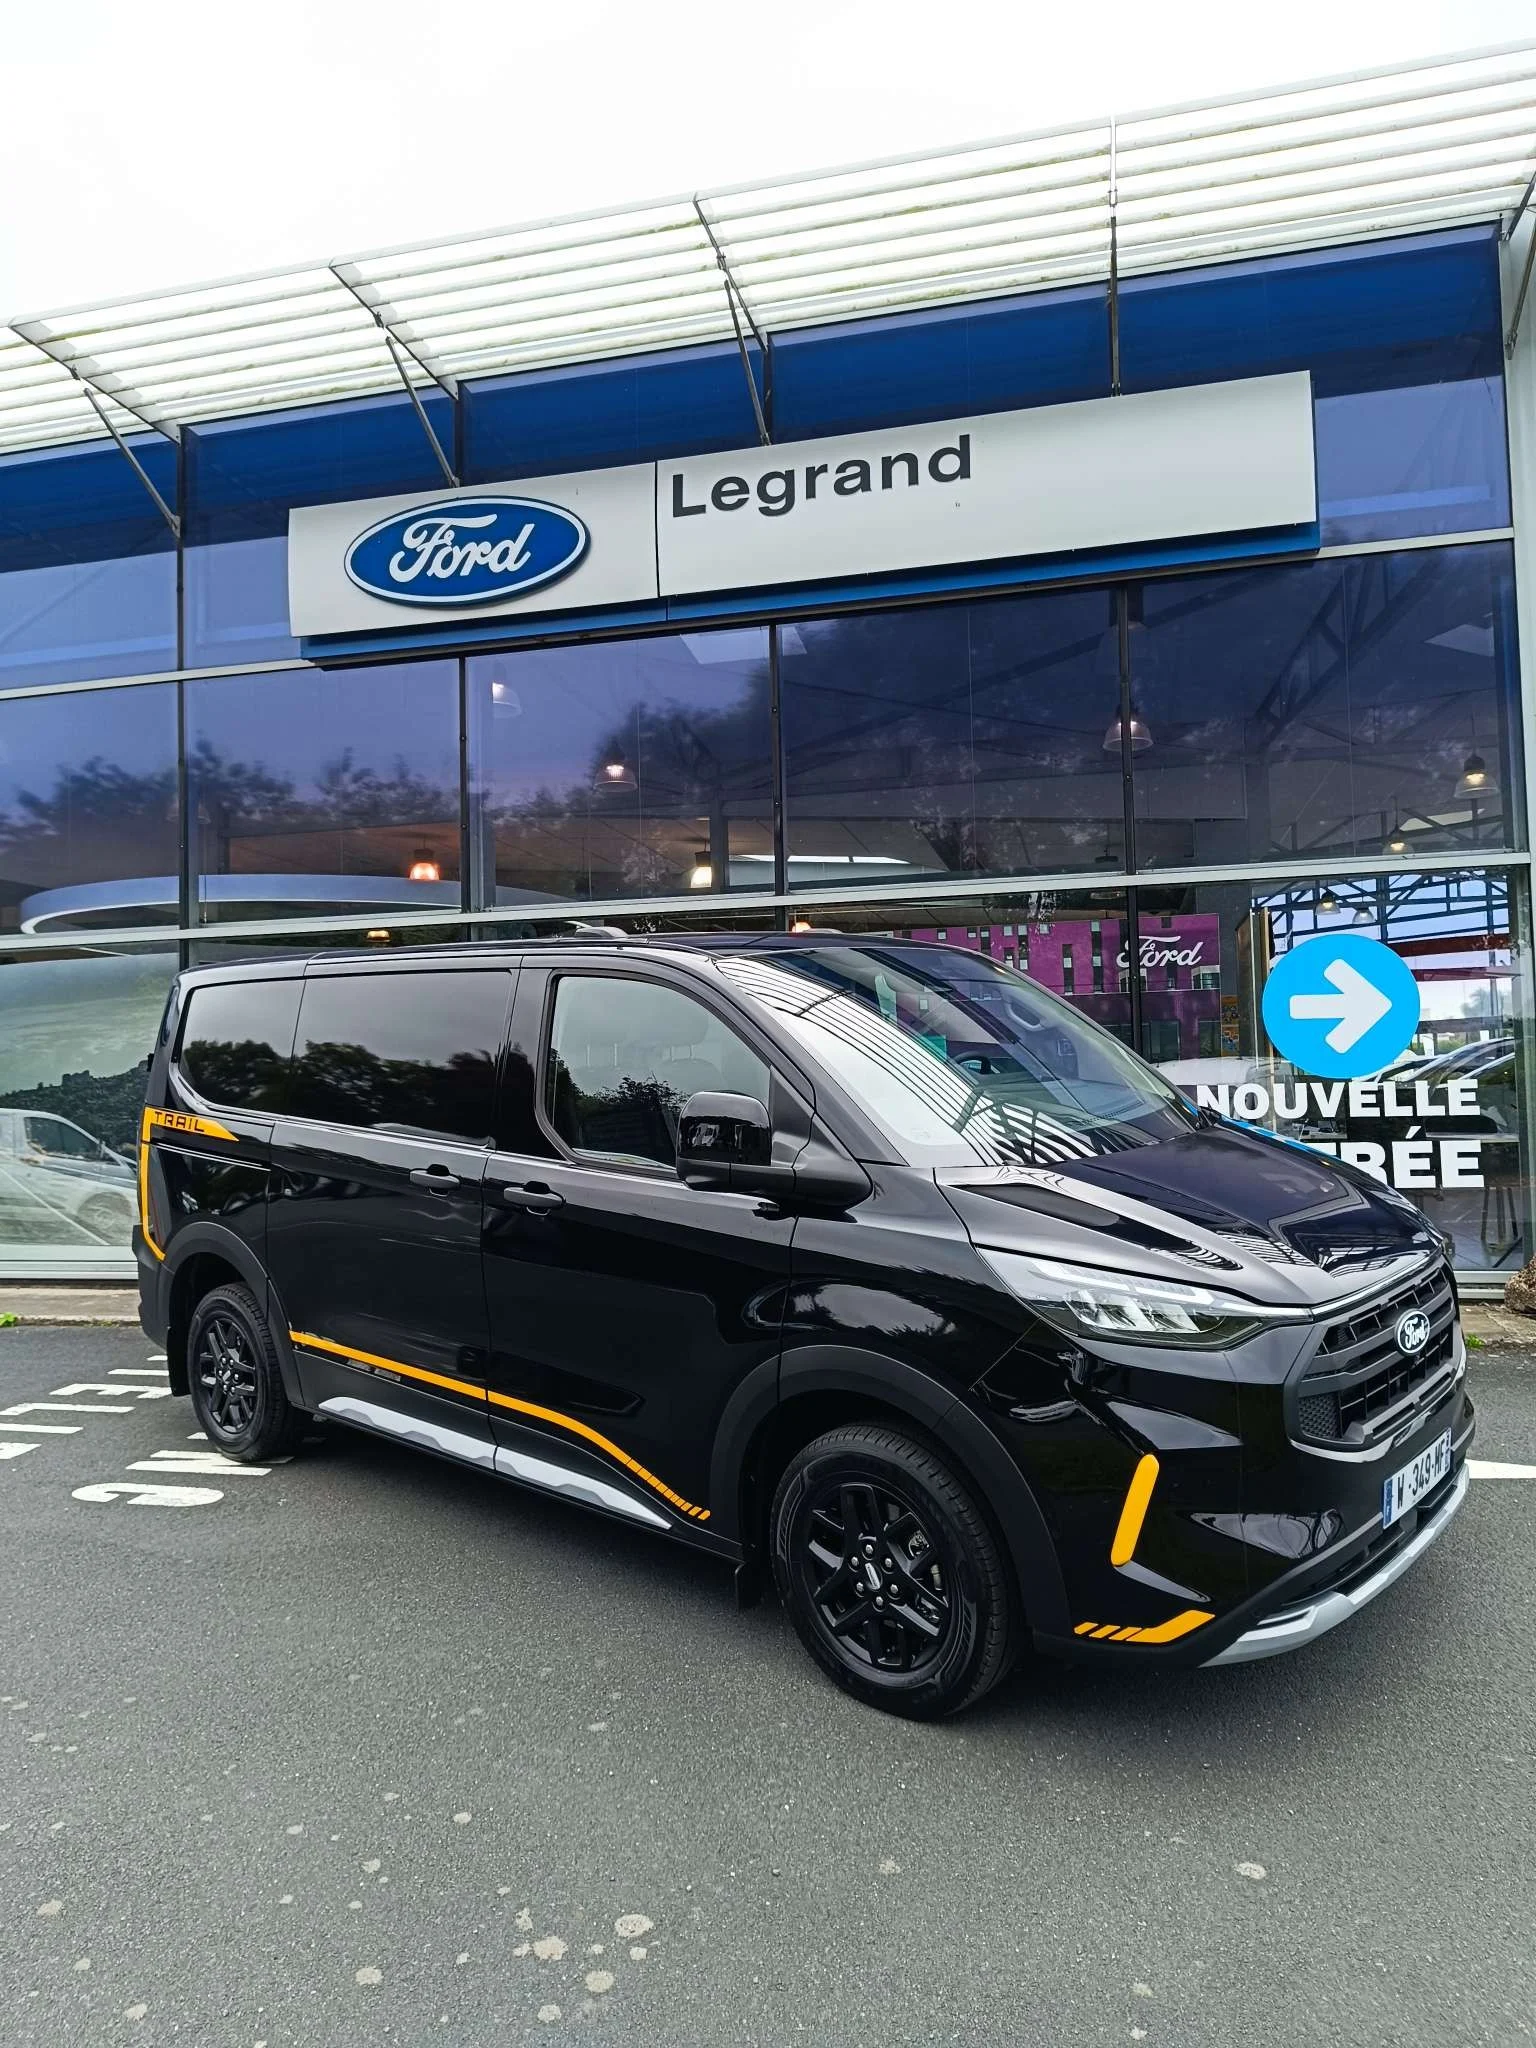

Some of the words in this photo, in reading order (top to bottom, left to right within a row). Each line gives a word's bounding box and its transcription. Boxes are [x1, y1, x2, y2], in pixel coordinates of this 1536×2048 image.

[673, 434, 971, 517] Legrand
[389, 514, 535, 583] Ford
[1116, 936, 1204, 968] Ford
[1197, 1079, 1480, 1120] NOUVELLE
[155, 1111, 204, 1132] TRAIL
[1405, 1317, 1426, 1349] Ford
